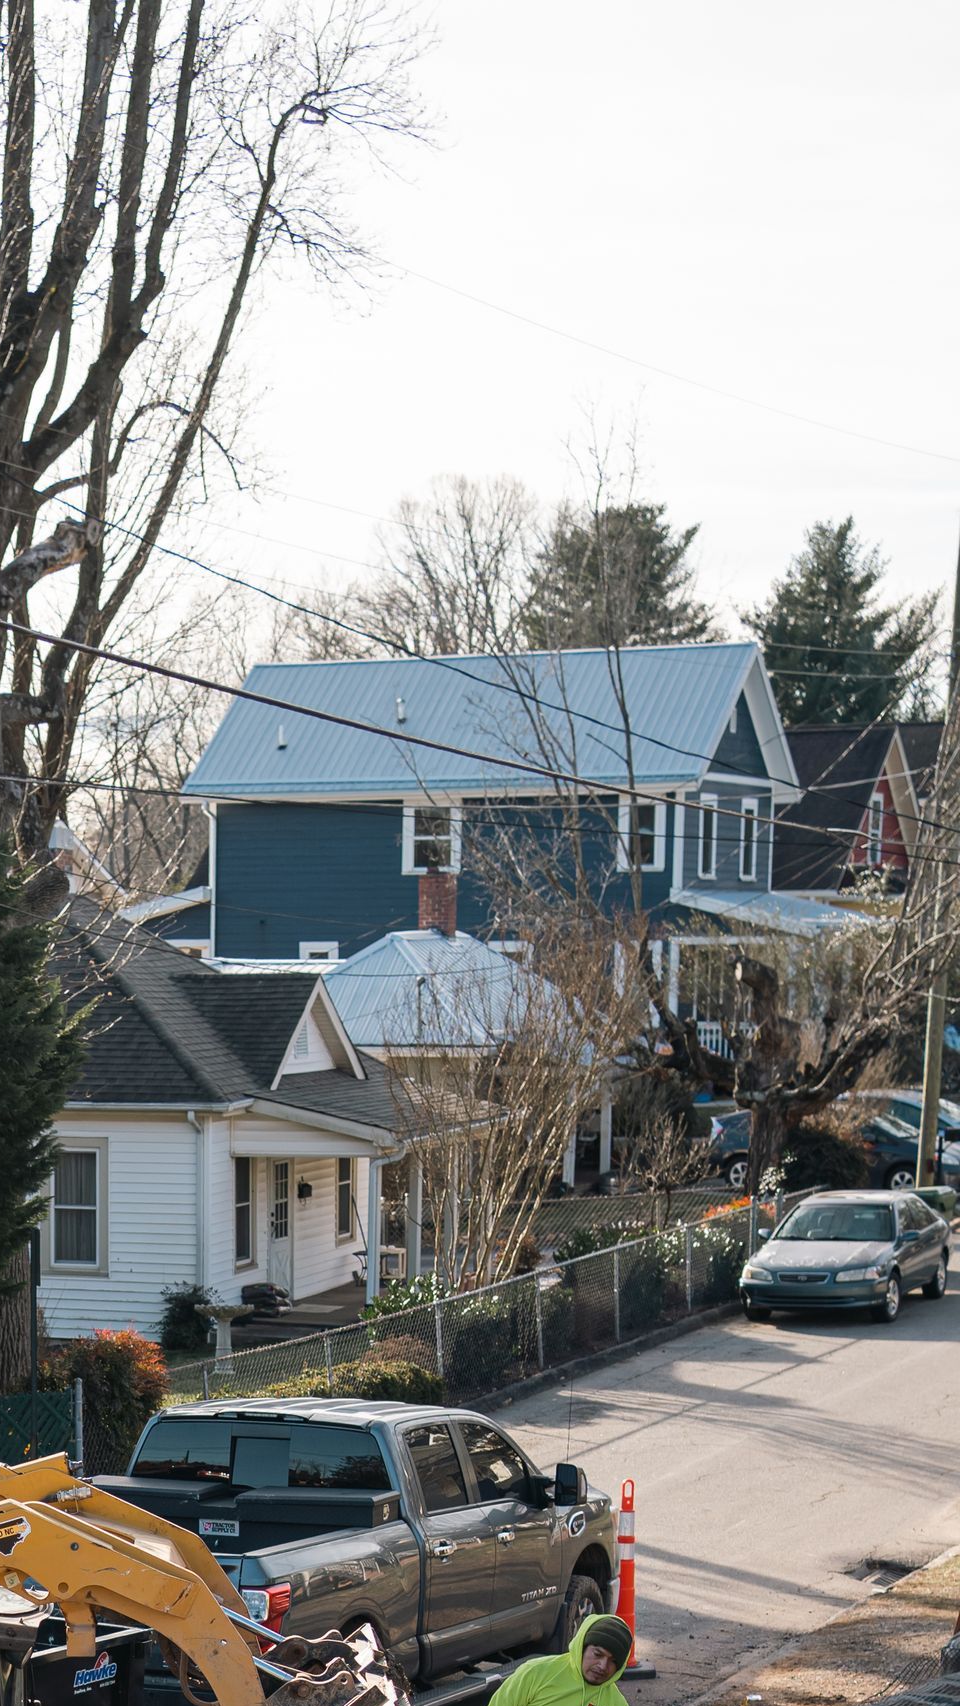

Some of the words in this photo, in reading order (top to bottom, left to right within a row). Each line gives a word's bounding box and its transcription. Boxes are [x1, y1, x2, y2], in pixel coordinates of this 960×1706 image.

[4, 1527, 15, 1536] NC
[521, 1588, 544, 1602] TITAN
[545, 1585, 558, 1596] XD
[73, 1662, 117, 1688] Hawke
